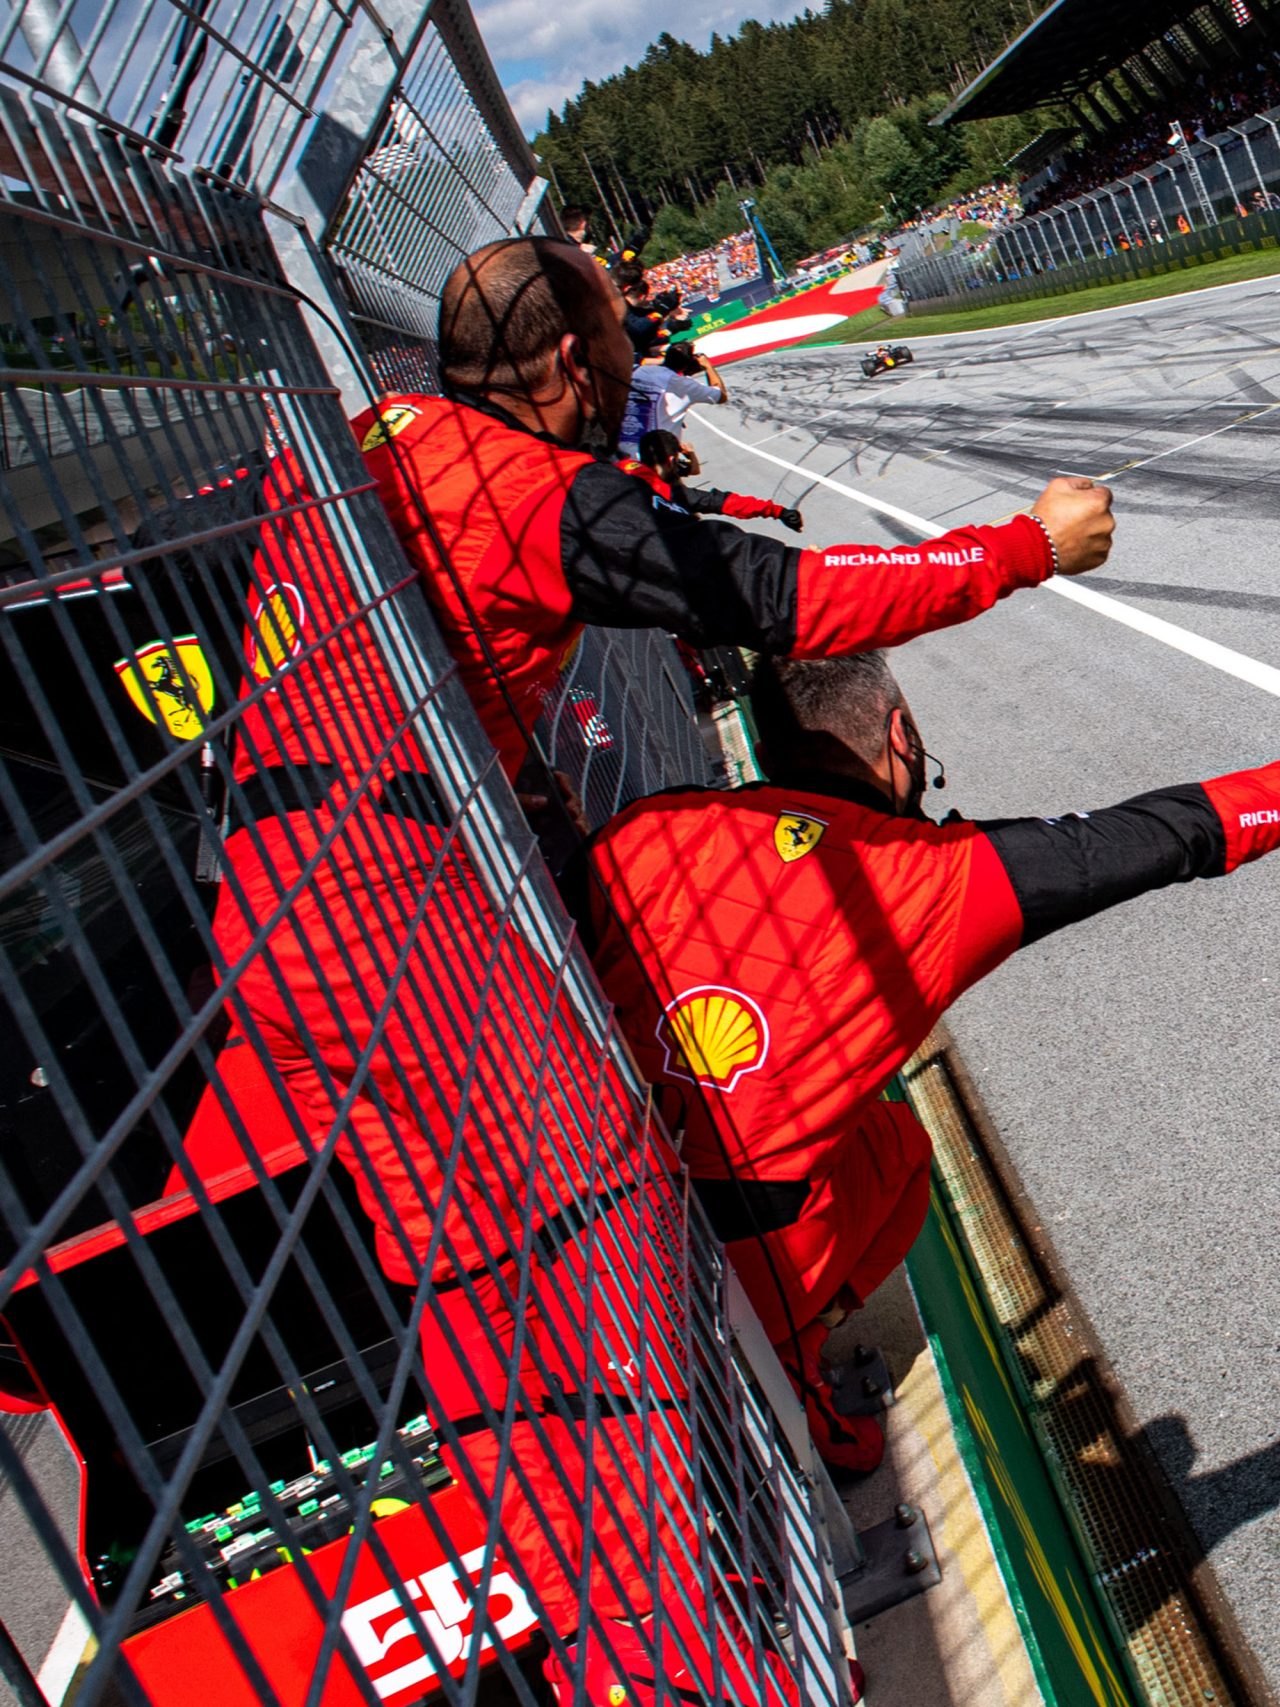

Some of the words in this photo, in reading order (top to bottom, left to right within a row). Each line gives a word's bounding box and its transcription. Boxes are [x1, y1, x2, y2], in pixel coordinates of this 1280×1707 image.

[696, 318, 726, 335] ROLEX
[824, 552, 921, 567] RICHARD
[927, 547, 985, 567] MILLE
[340, 1544, 540, 1700] 55
